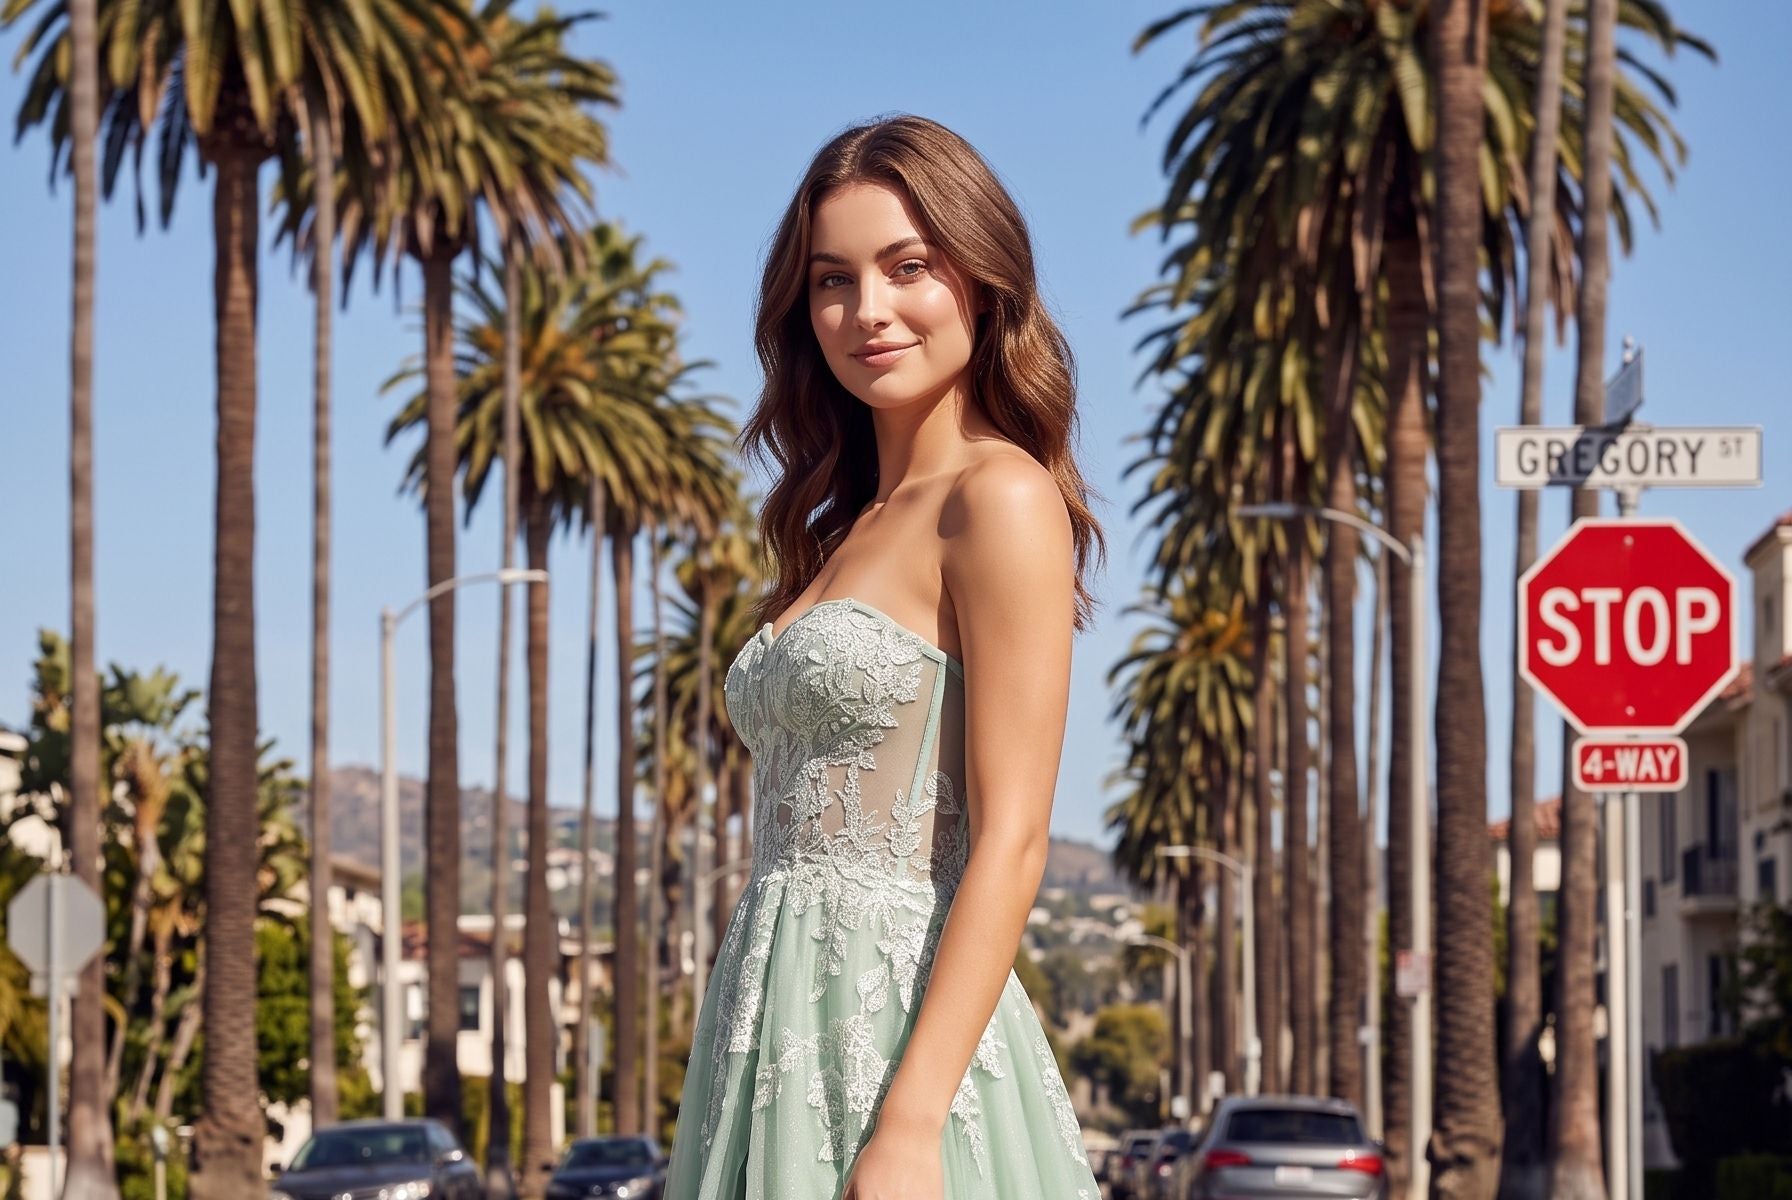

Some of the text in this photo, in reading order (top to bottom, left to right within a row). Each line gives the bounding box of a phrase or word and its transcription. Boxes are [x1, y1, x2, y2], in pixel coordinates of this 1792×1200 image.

[1516, 437, 1744, 477] GREGORY ST
[1537, 587, 1721, 667] STOP
[1582, 747, 1677, 782] 4-WAY
